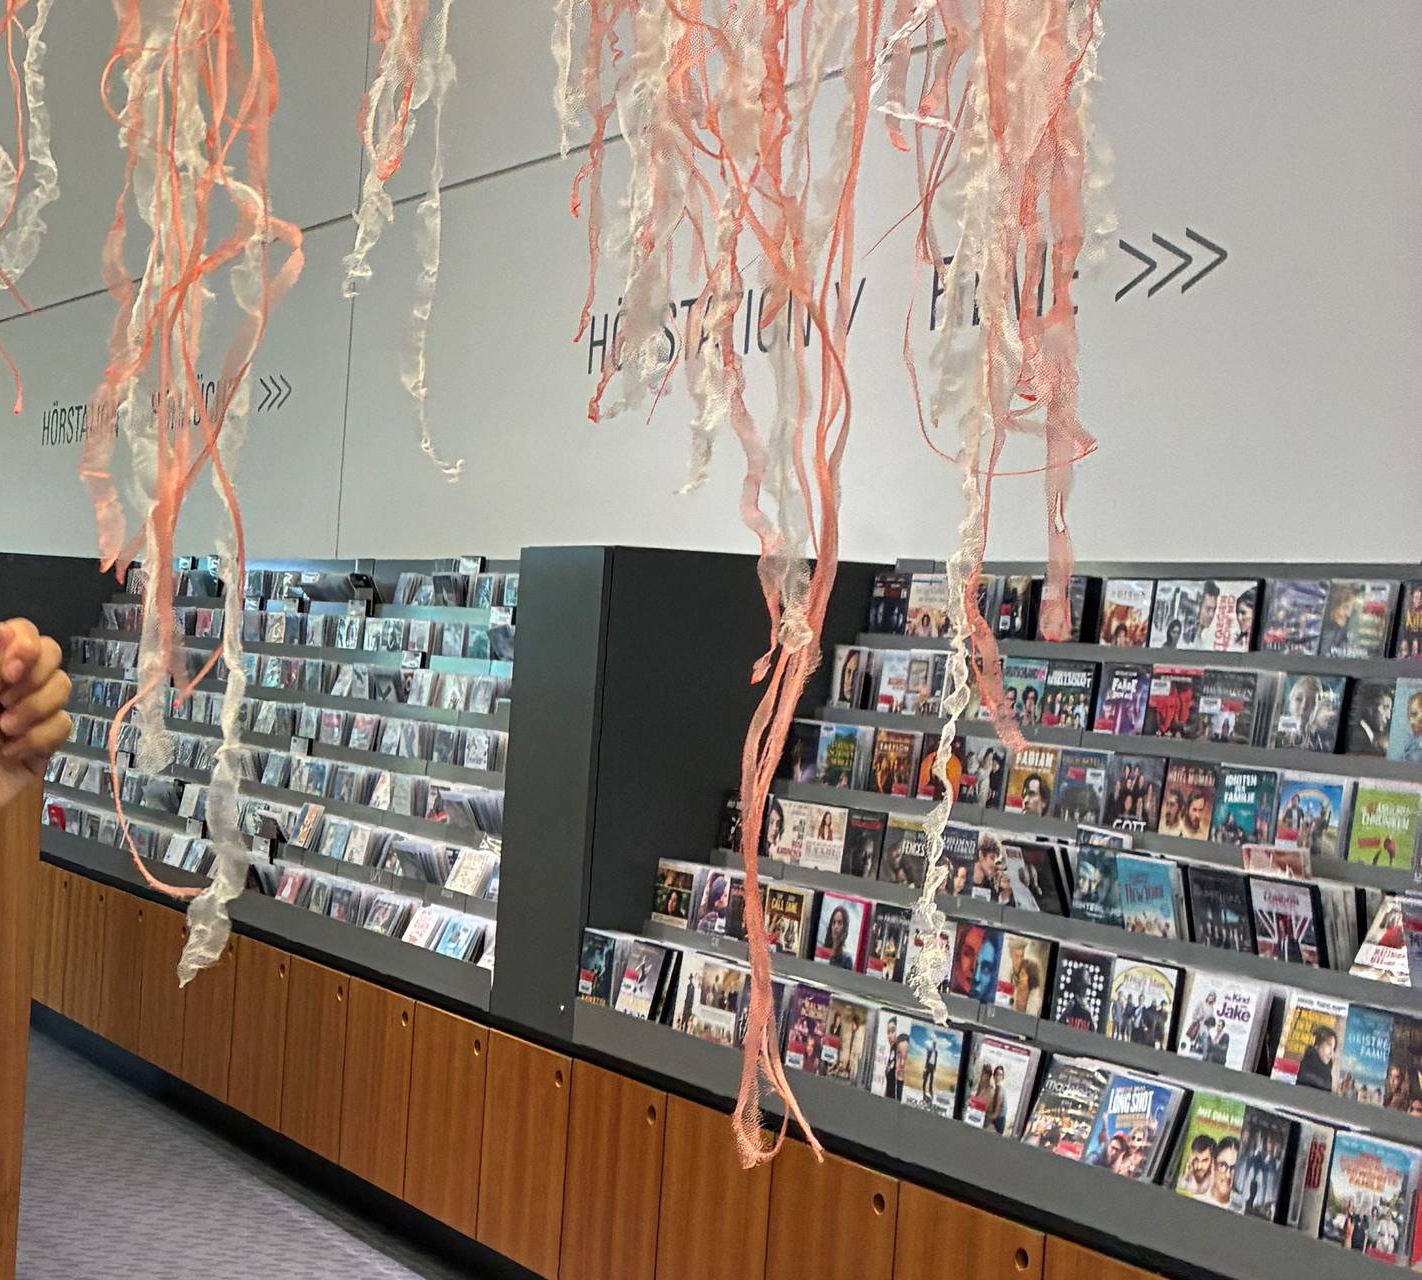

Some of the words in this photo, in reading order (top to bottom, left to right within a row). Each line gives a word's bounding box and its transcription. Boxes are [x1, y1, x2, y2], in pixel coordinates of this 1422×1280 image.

[1232, 992, 1250, 1004] Kind
[1216, 1001, 1252, 1022] Jake
[1109, 1088, 1131, 1114] LONG
[1130, 1089, 1155, 1119] SHOT
